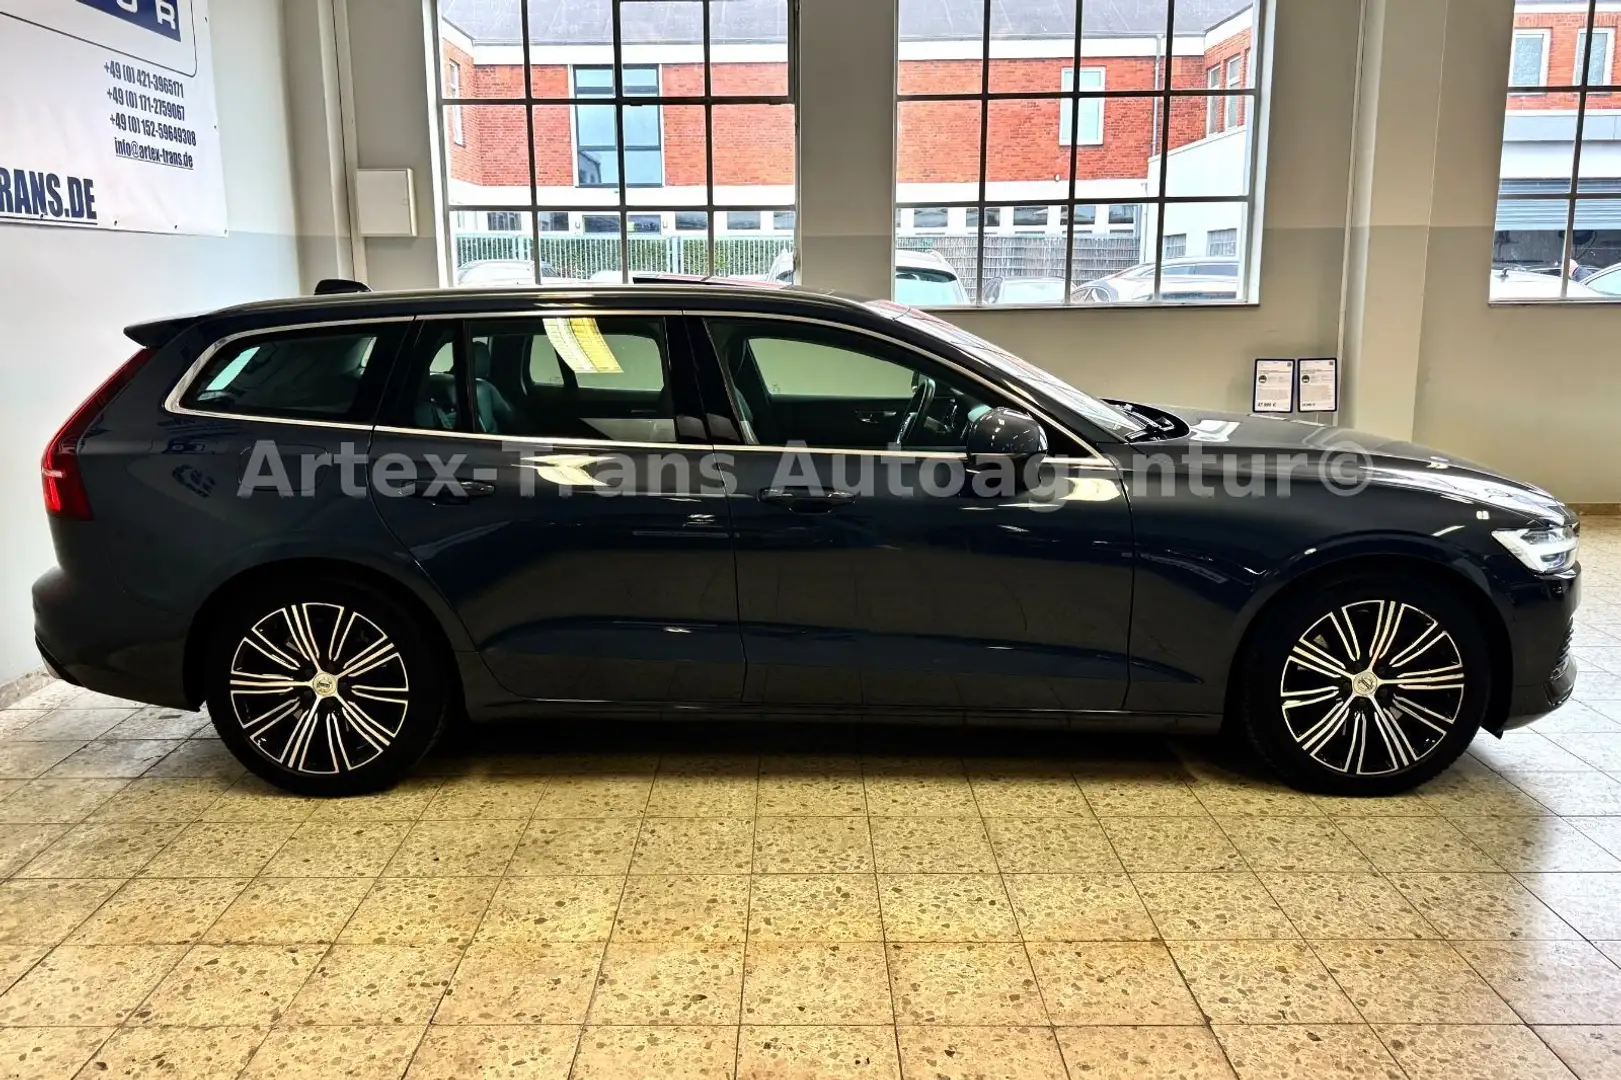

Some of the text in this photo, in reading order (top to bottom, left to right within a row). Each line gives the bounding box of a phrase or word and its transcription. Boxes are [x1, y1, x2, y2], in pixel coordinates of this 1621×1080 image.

[103, 60, 185, 99] +49 (0) 421-3965171
[106, 86, 186, 121] +49 (0) 171-2759067
[109, 112, 197, 147] +49 (0) 152-59649308
[114, 136, 194, 169] info@artex-trans.de
